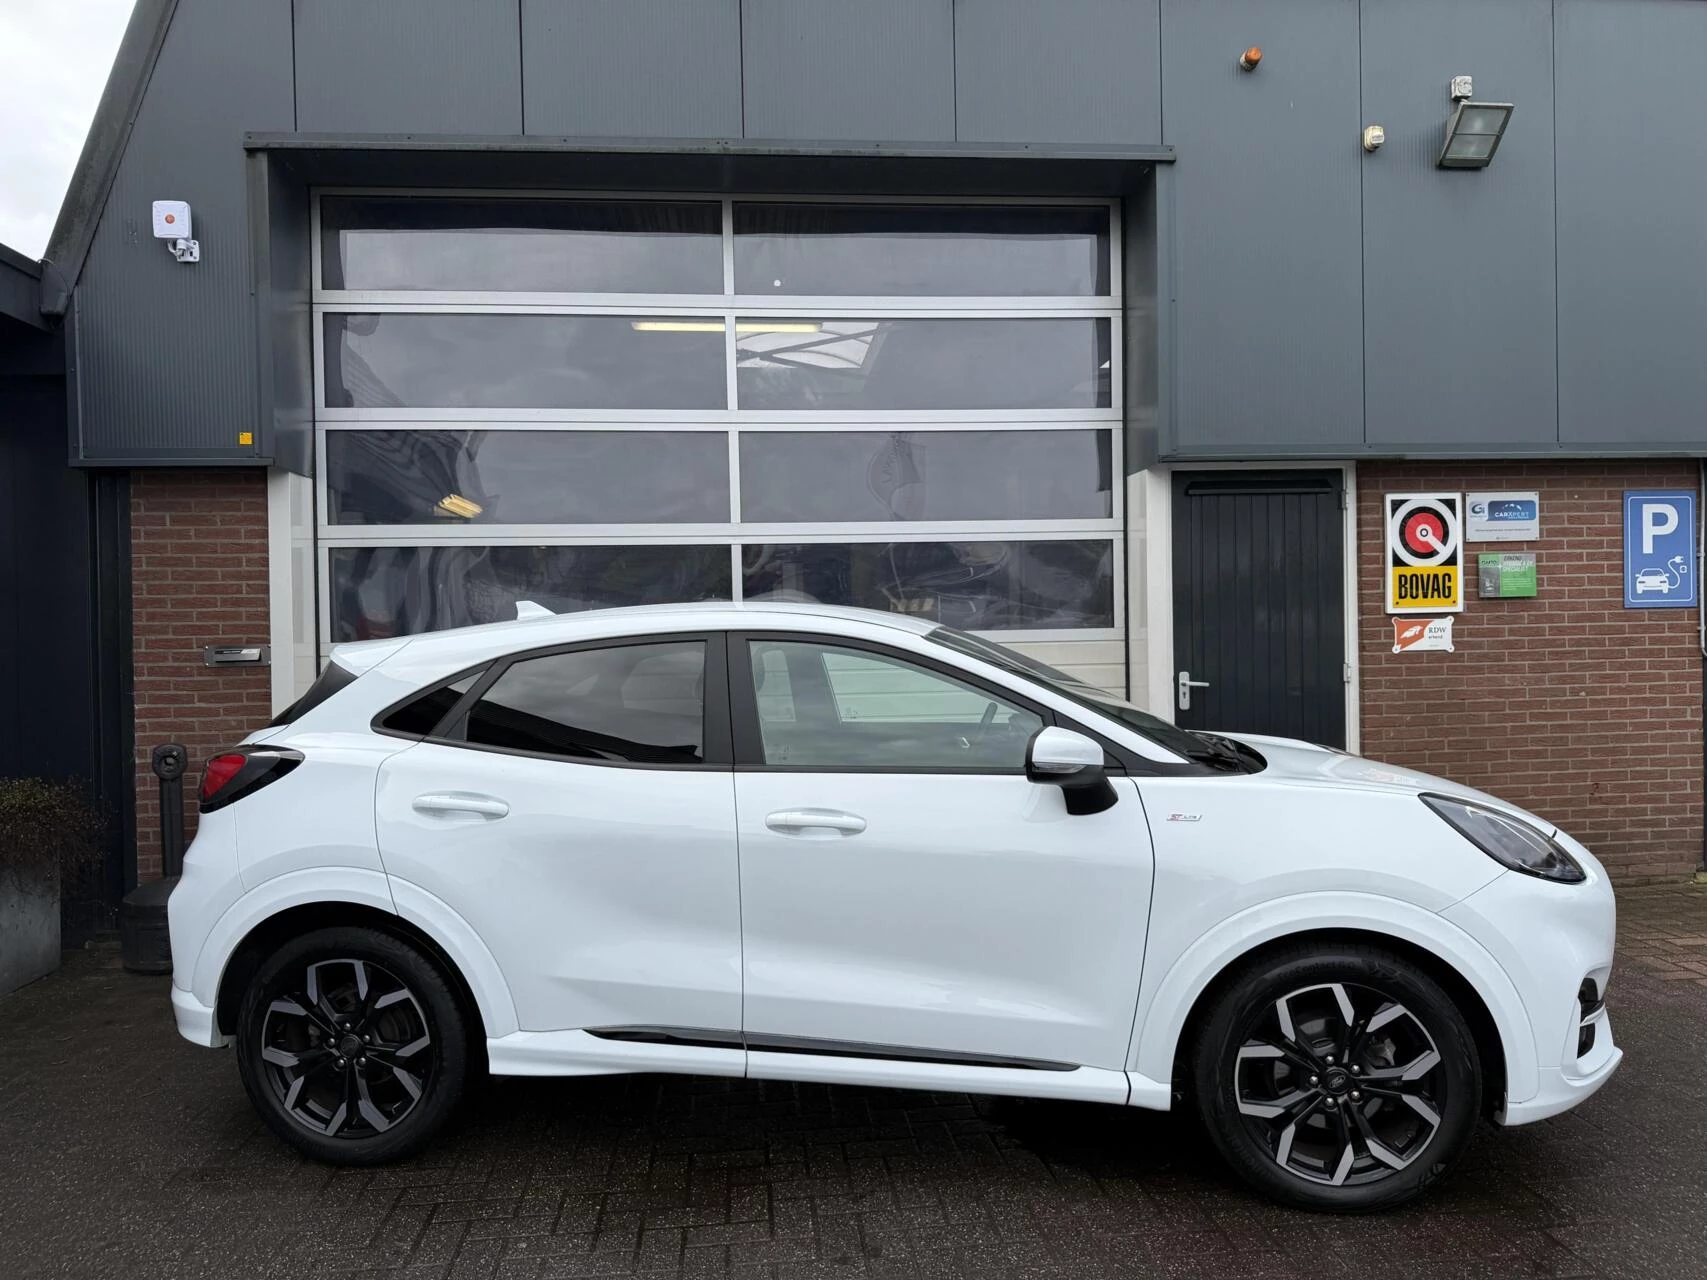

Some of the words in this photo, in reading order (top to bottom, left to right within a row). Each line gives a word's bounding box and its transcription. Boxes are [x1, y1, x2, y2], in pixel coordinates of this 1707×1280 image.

[1642, 503, 1679, 554] P
[1398, 573, 1452, 599] BOVAG
[1428, 626, 1447, 634] RDW
